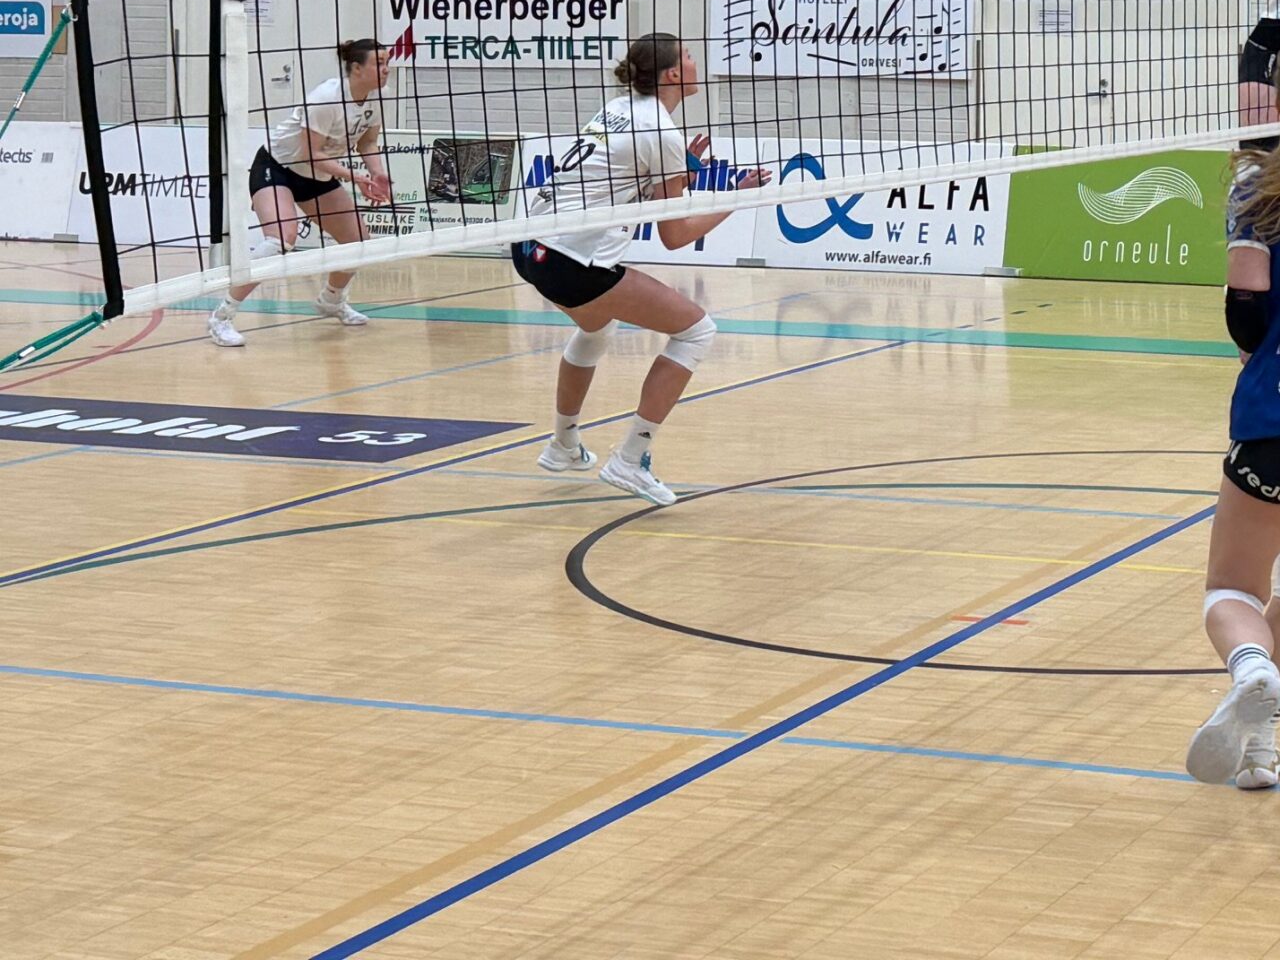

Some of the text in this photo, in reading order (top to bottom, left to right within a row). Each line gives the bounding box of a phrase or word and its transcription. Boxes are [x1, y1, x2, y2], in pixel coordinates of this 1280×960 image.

[424, 35, 619, 60] TERCA-TIILET
[140, 173, 212, 198] TIMBE
[885, 220, 986, 246] WEAR
[1083, 223, 1189, 265] orneule
[824, 249, 932, 266] www.alfawear.fi
[317, 430, 428, 446] 53
